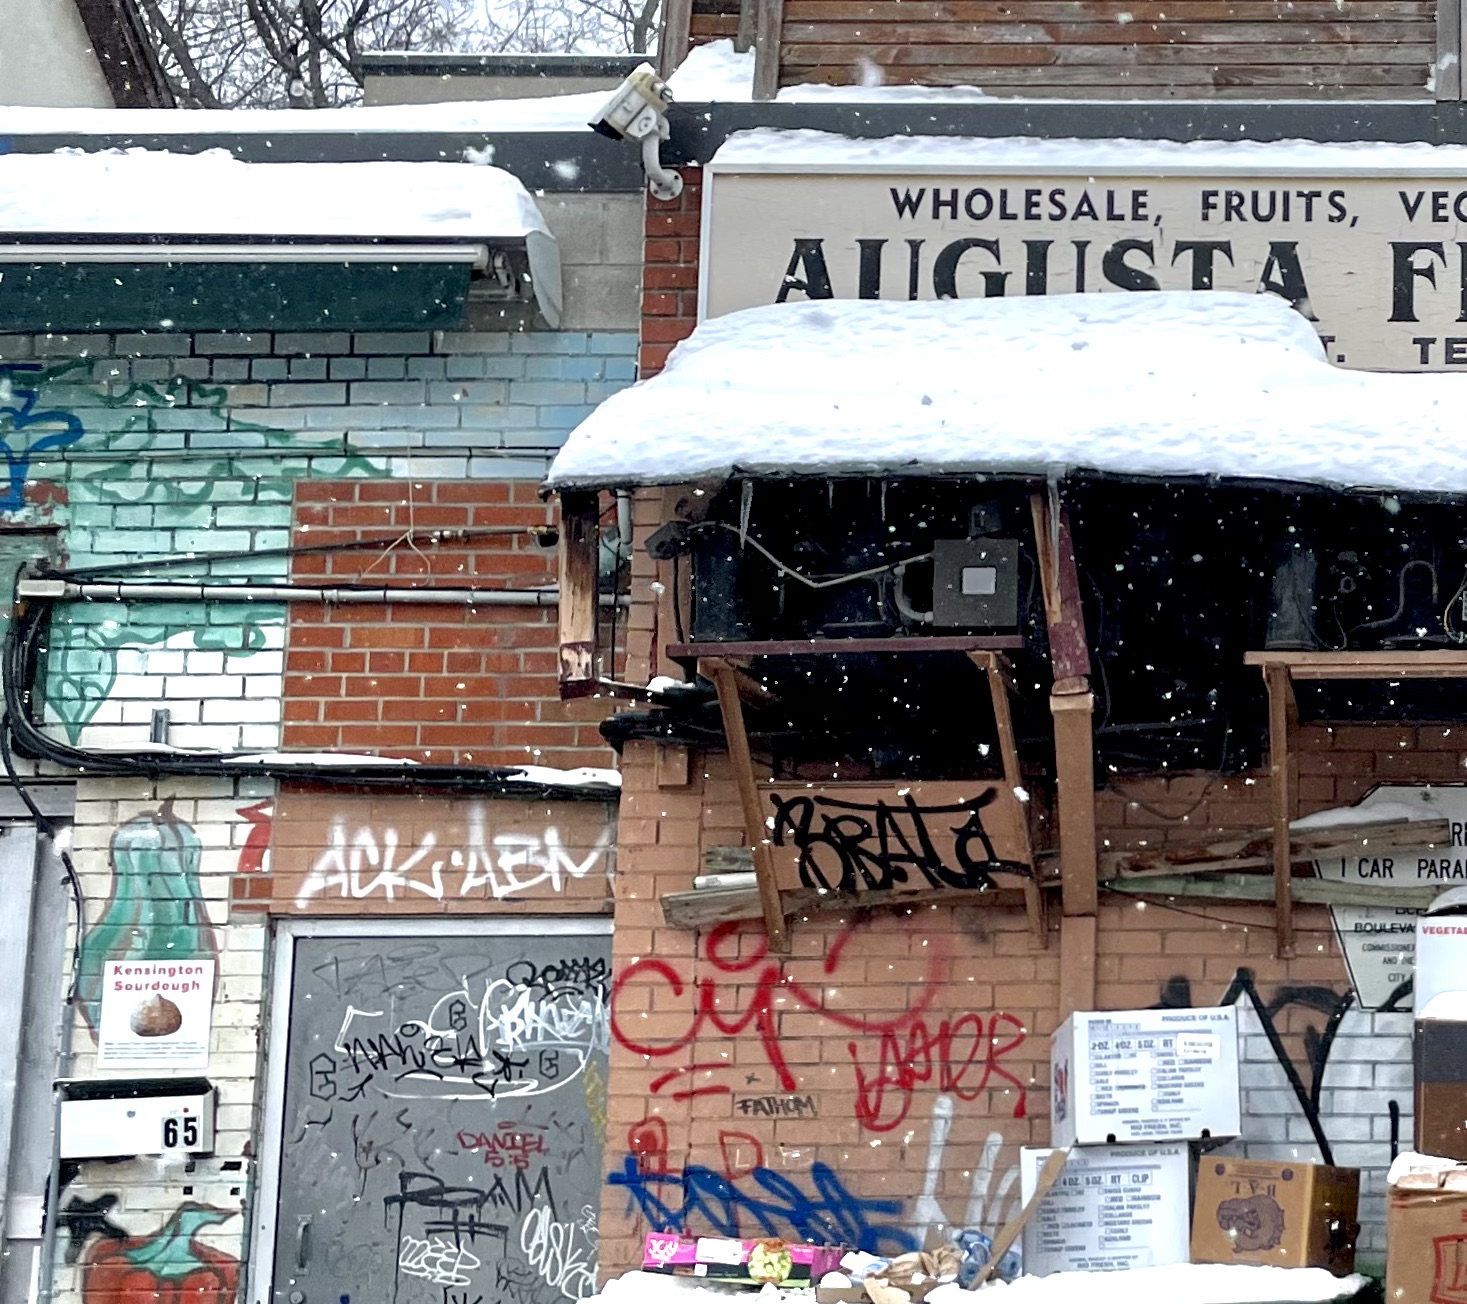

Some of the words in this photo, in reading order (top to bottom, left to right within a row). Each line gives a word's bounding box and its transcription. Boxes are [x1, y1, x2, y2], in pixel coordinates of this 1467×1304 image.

[890, 187, 1163, 227] WHOLESALE,
[1201, 189, 1360, 228] FRUITS,
[775, 237, 1320, 322] AUGUSTA
[1357, 858, 1394, 879] CAR
[1354, 923, 1416, 934] BOULEVA
[113, 964, 204, 978] Kensington
[113, 980, 201, 993] Sourdough
[163, 1117, 198, 1148] 65
[456, 1129, 546, 1154] DANIEL
